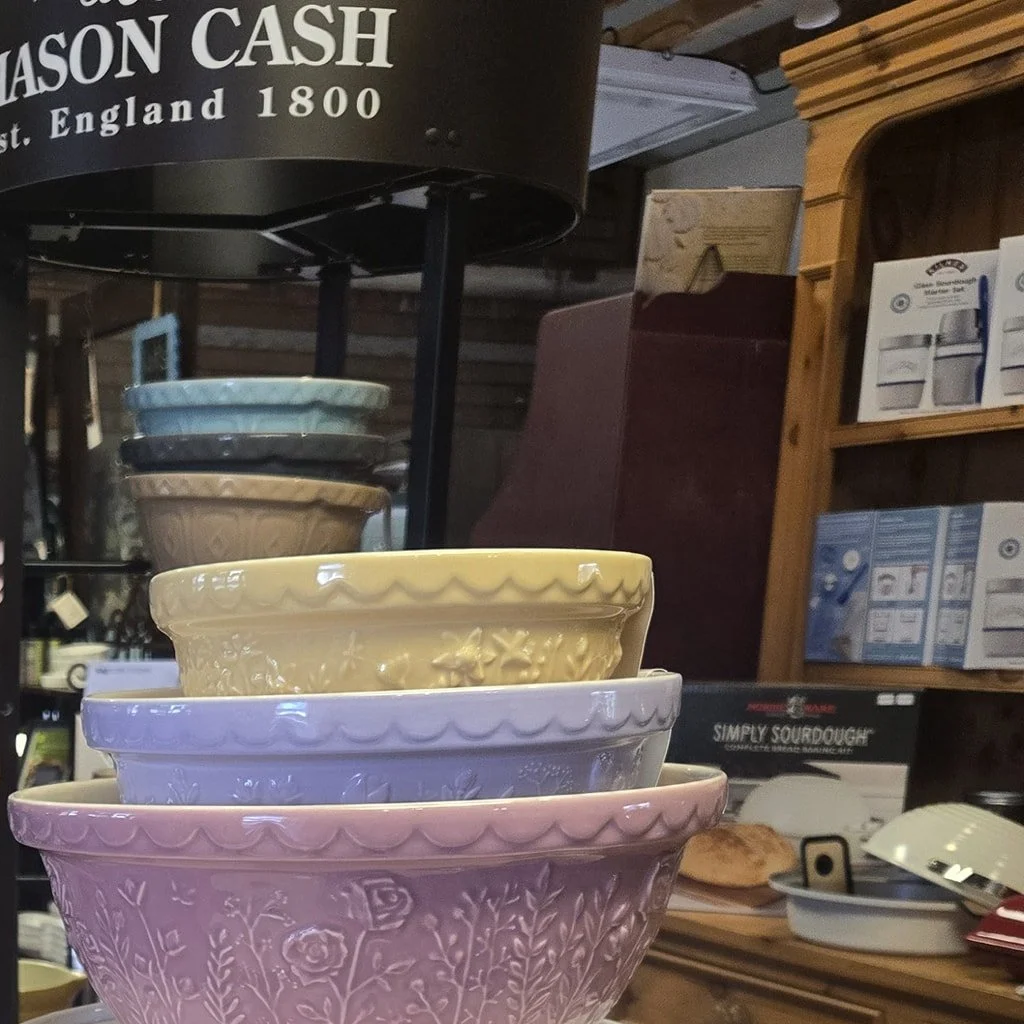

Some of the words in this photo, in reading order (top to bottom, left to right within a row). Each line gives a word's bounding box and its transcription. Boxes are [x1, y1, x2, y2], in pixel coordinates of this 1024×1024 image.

[191, 4, 397, 69] CASH
[49, 88, 225, 138] England
[257, 85, 381, 119] 1800
[713, 723, 767, 743] SIMPLY
